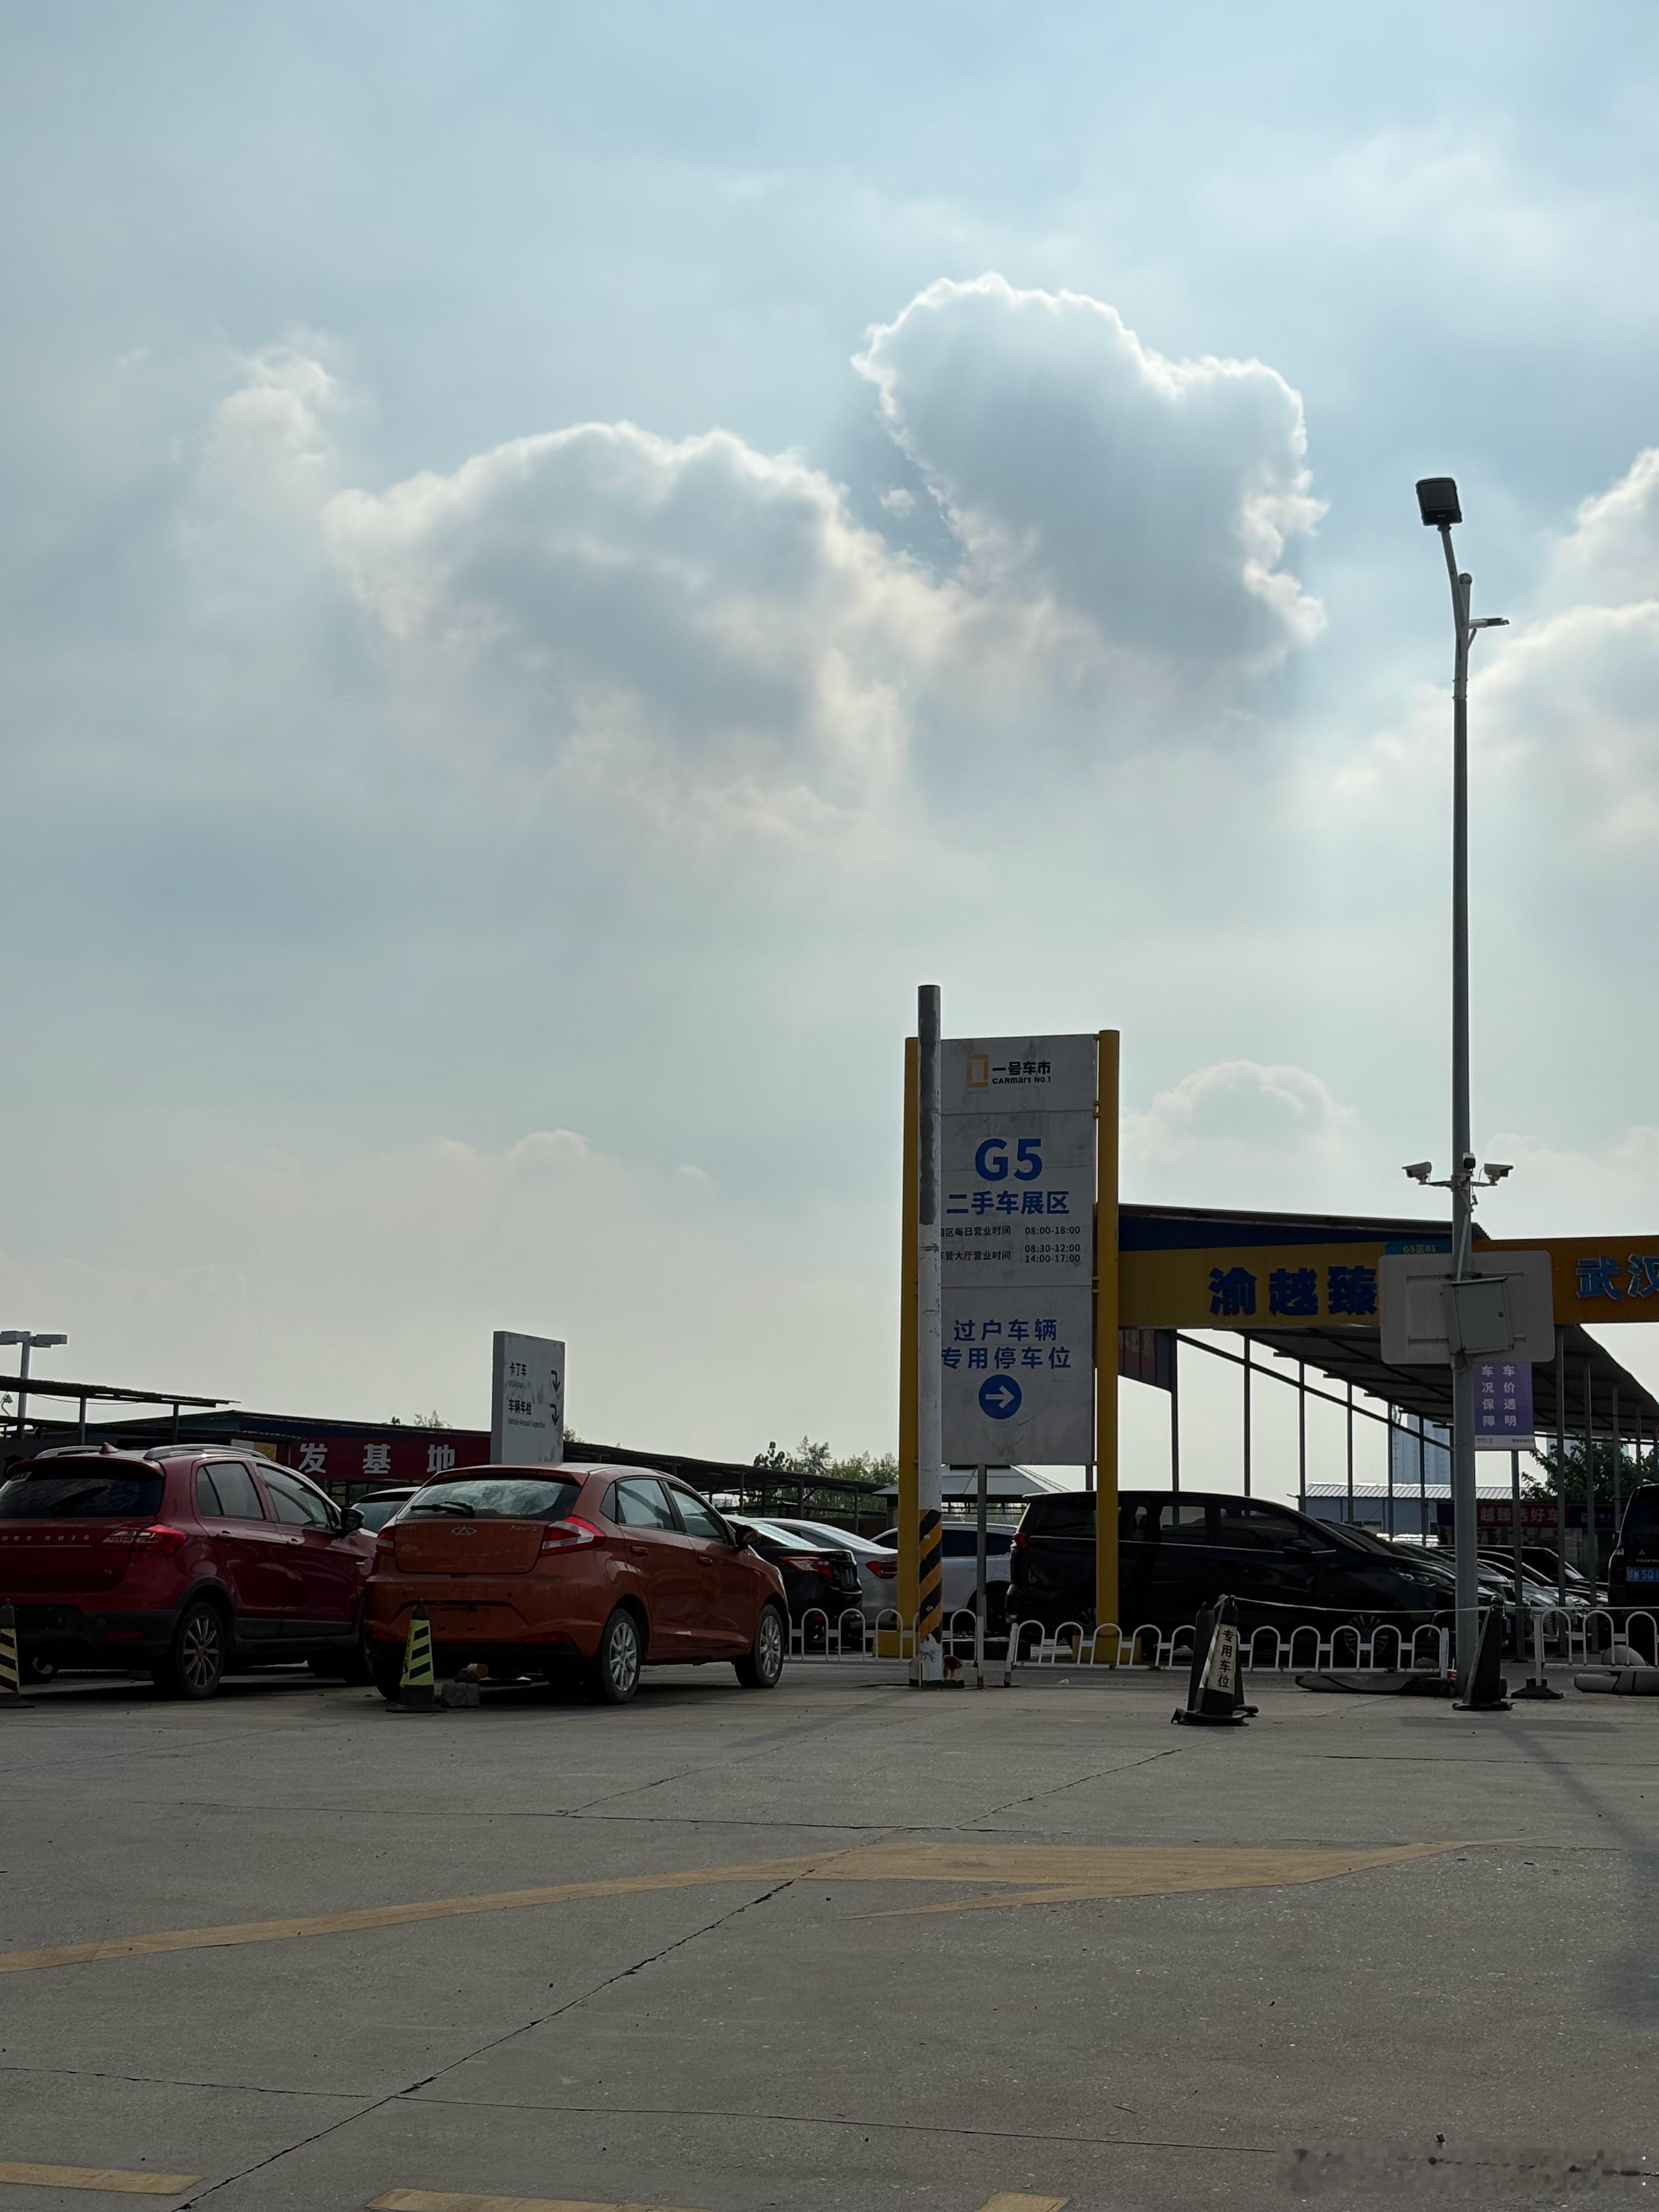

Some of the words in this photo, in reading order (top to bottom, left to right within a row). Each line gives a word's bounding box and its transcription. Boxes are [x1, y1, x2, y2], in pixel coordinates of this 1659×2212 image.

[992, 1060, 1051, 1075] 一号车市
[975, 1138, 1042, 1181] G5
[946, 1190, 1069, 1215] 二手车展区
[1025, 1226, 1080, 1235] 08:00-18:00
[1025, 1244, 1080, 1252] 08:30-12:00
[1025, 1254, 1080, 1263] 14:00-17:00
[1403, 1244, 1436, 1254] G5区01
[1576, 1253, 1659, 1301] 武汉
[953, 1318, 1057, 1341] 过户车辆
[941, 1346, 1071, 1369] 专用停车位
[509, 1362, 527, 1378] 卡丁车
[1481, 1365, 1495, 1426] 车况保障
[1503, 1365, 1516, 1426] 车价透明
[298, 1443, 455, 1474] 发基地
[1217, 1629, 1235, 1688] 专用车位
